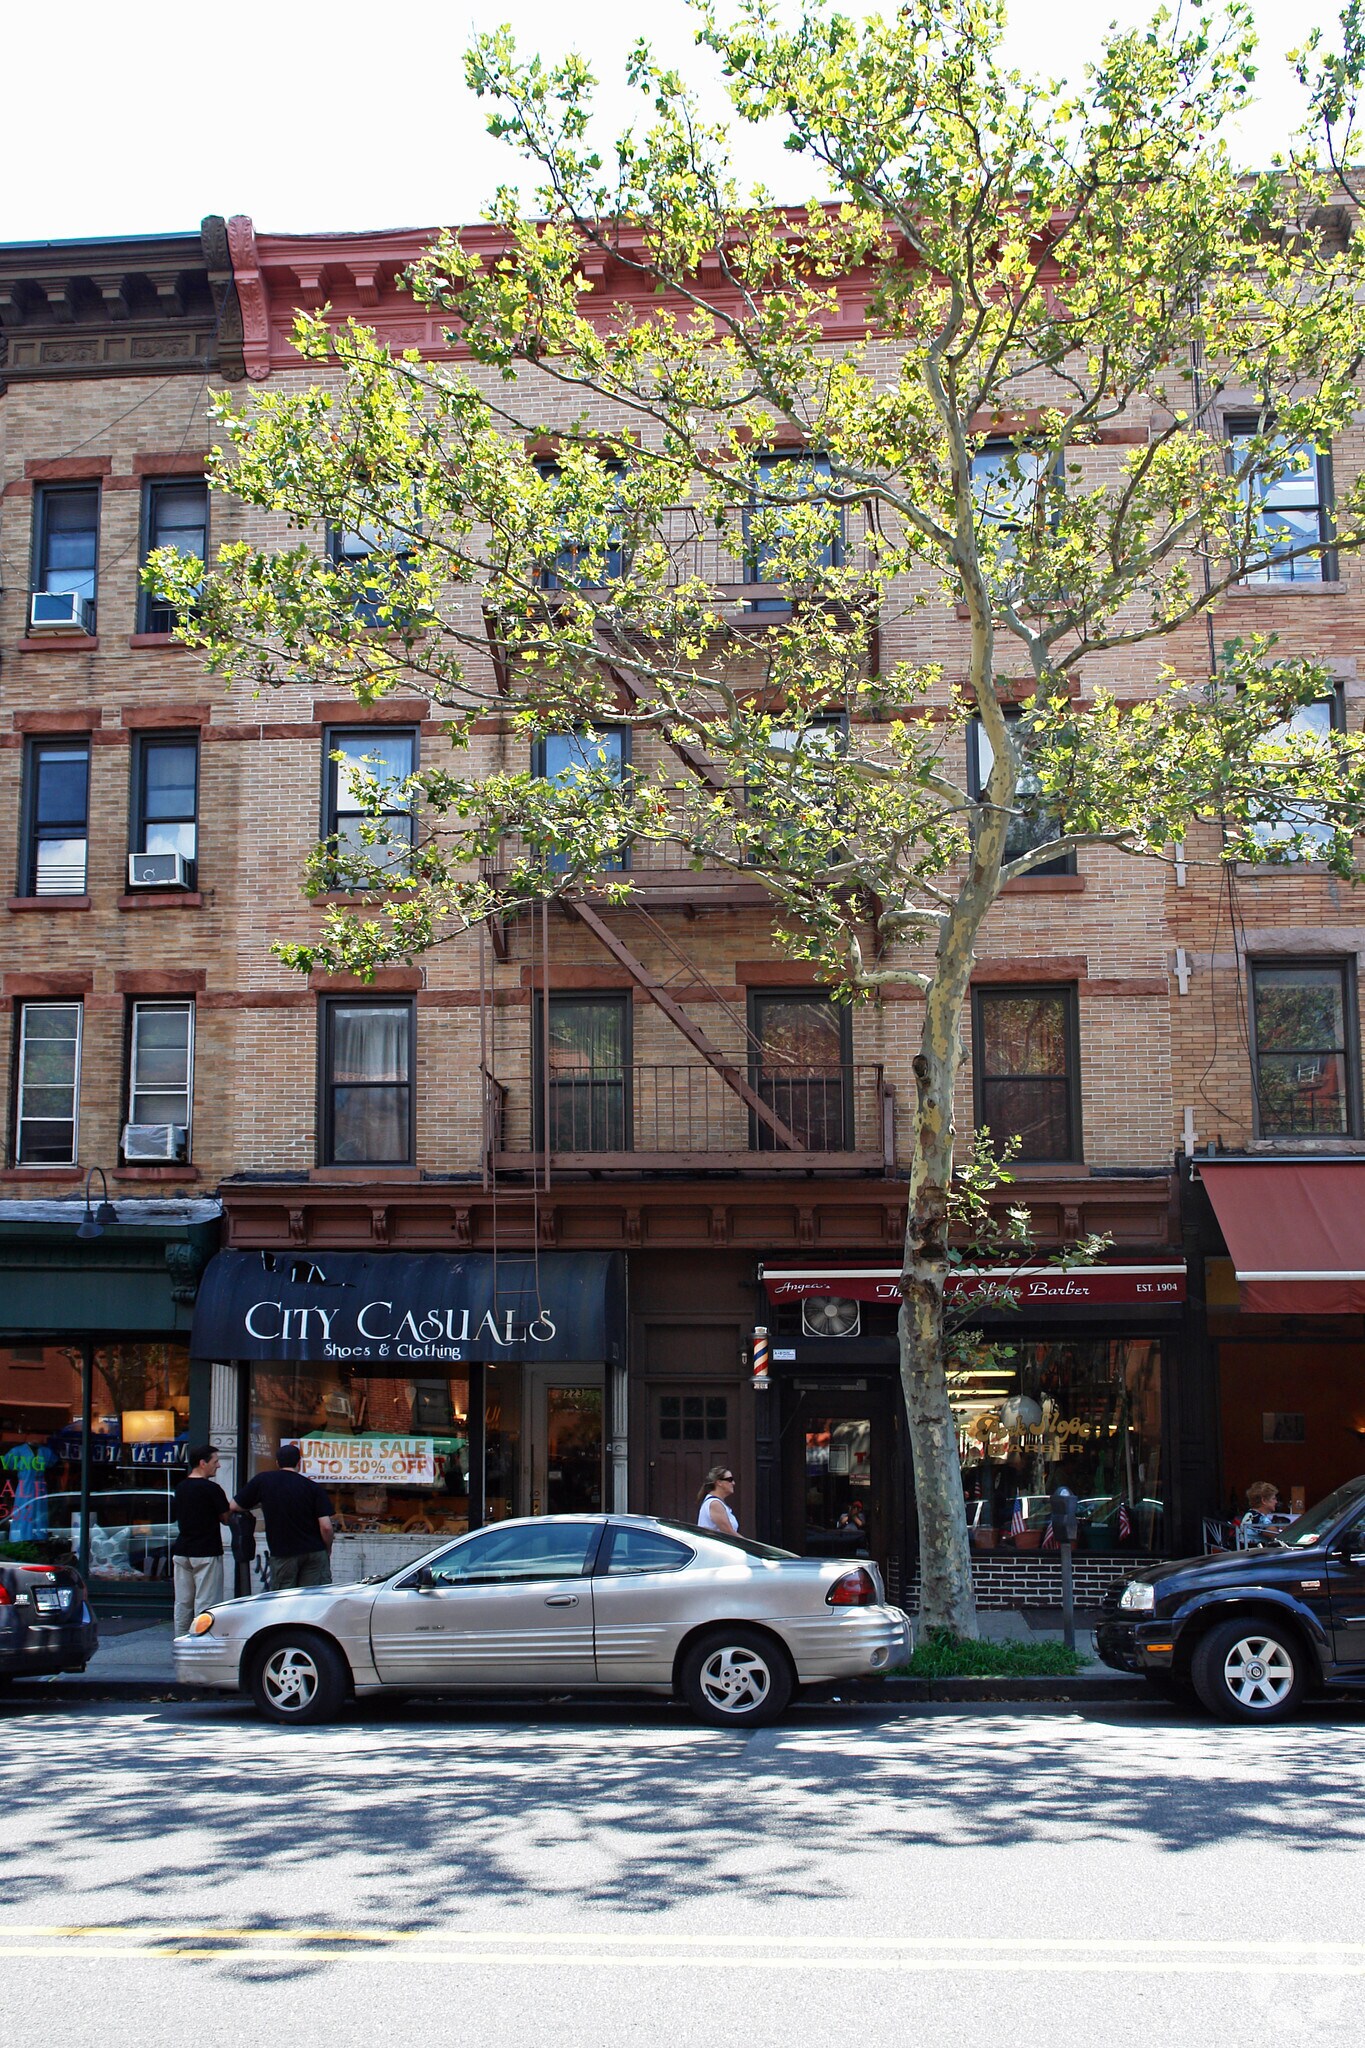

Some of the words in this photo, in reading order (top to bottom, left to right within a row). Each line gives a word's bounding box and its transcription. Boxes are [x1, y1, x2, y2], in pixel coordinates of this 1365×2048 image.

[876, 1284, 903, 1298] Th
[1027, 1280, 1090, 1297] Barber
[1136, 1283, 1153, 1292] EST.
[1156, 1282, 1177, 1292] 1904
[244, 1301, 340, 1340] CITY
[356, 1301, 557, 1346] CASUALS
[323, 1343, 371, 1358] Shoes
[378, 1344, 390, 1357] &
[396, 1343, 461, 1360] Clothing
[379, 1440, 427, 1458] SALE
[988, 1444, 1084, 1456] BARBER
[297, 1460, 312, 1474] P
[317, 1460, 343, 1474] TO
[349, 1460, 386, 1474] 50%
[391, 1460, 427, 1474] OFF
